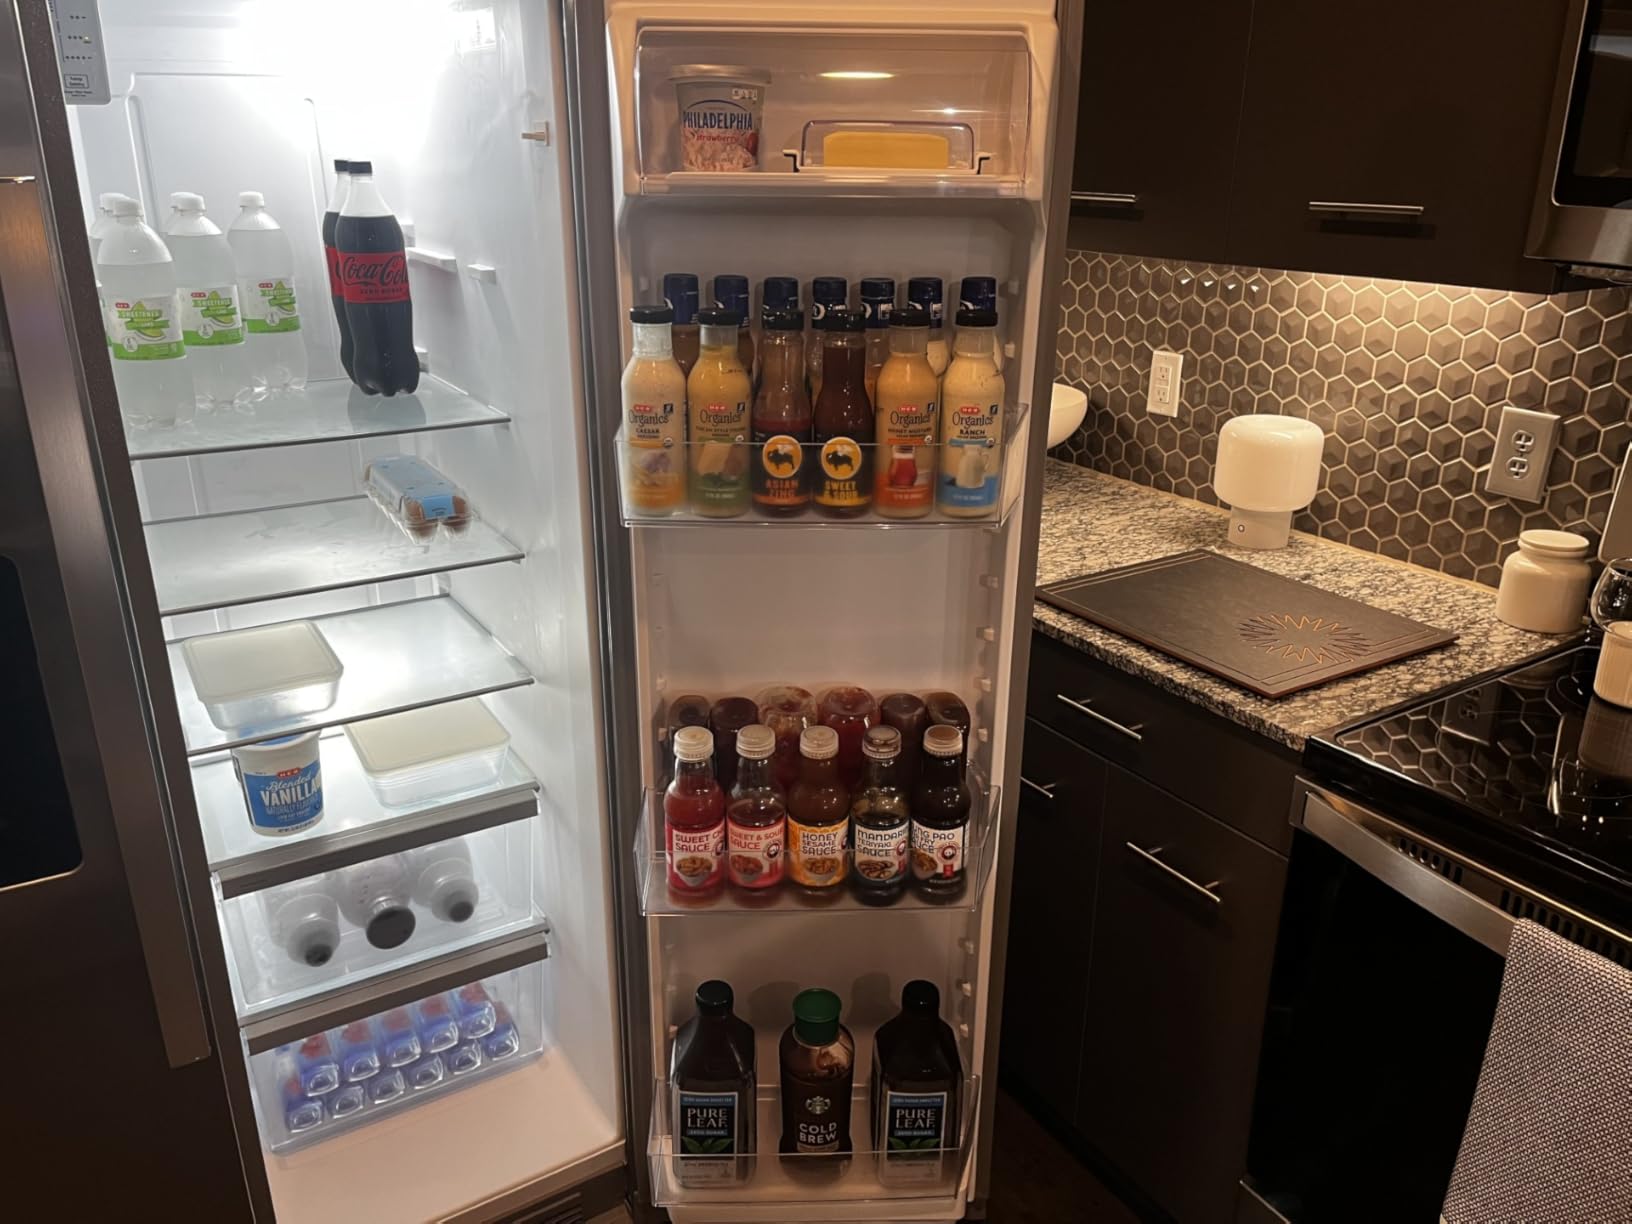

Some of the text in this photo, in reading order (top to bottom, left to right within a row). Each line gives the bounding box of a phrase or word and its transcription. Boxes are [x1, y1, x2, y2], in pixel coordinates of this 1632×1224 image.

[683, 111, 752, 130] PHILADELPHIA
[343, 256, 408, 286] Coca-Col
[629, 410, 669, 427] Organics
[700, 409, 742, 427] Organics
[890, 411, 931, 428] Organics
[952, 411, 994, 428] Organics
[265, 773, 311, 792] Blended
[260, 778, 318, 807] VANILLA
[675, 833, 710, 844] SWEET
[802, 832, 838, 842] HONEY
[933, 832, 955, 841] PAO
[675, 842, 710, 853] SAUCE
[730, 838, 761, 850] SAUCE
[802, 846, 837, 857] SAUCE
[857, 845, 891, 857] SAUCE
[688, 1108, 727, 1118] PURE
[896, 1109, 935, 1119] PURE
[687, 1118, 728, 1128] LEAF
[800, 1122, 837, 1134] COLD
[896, 1119, 936, 1129] LEAF
[800, 1131, 837, 1144] BREW
